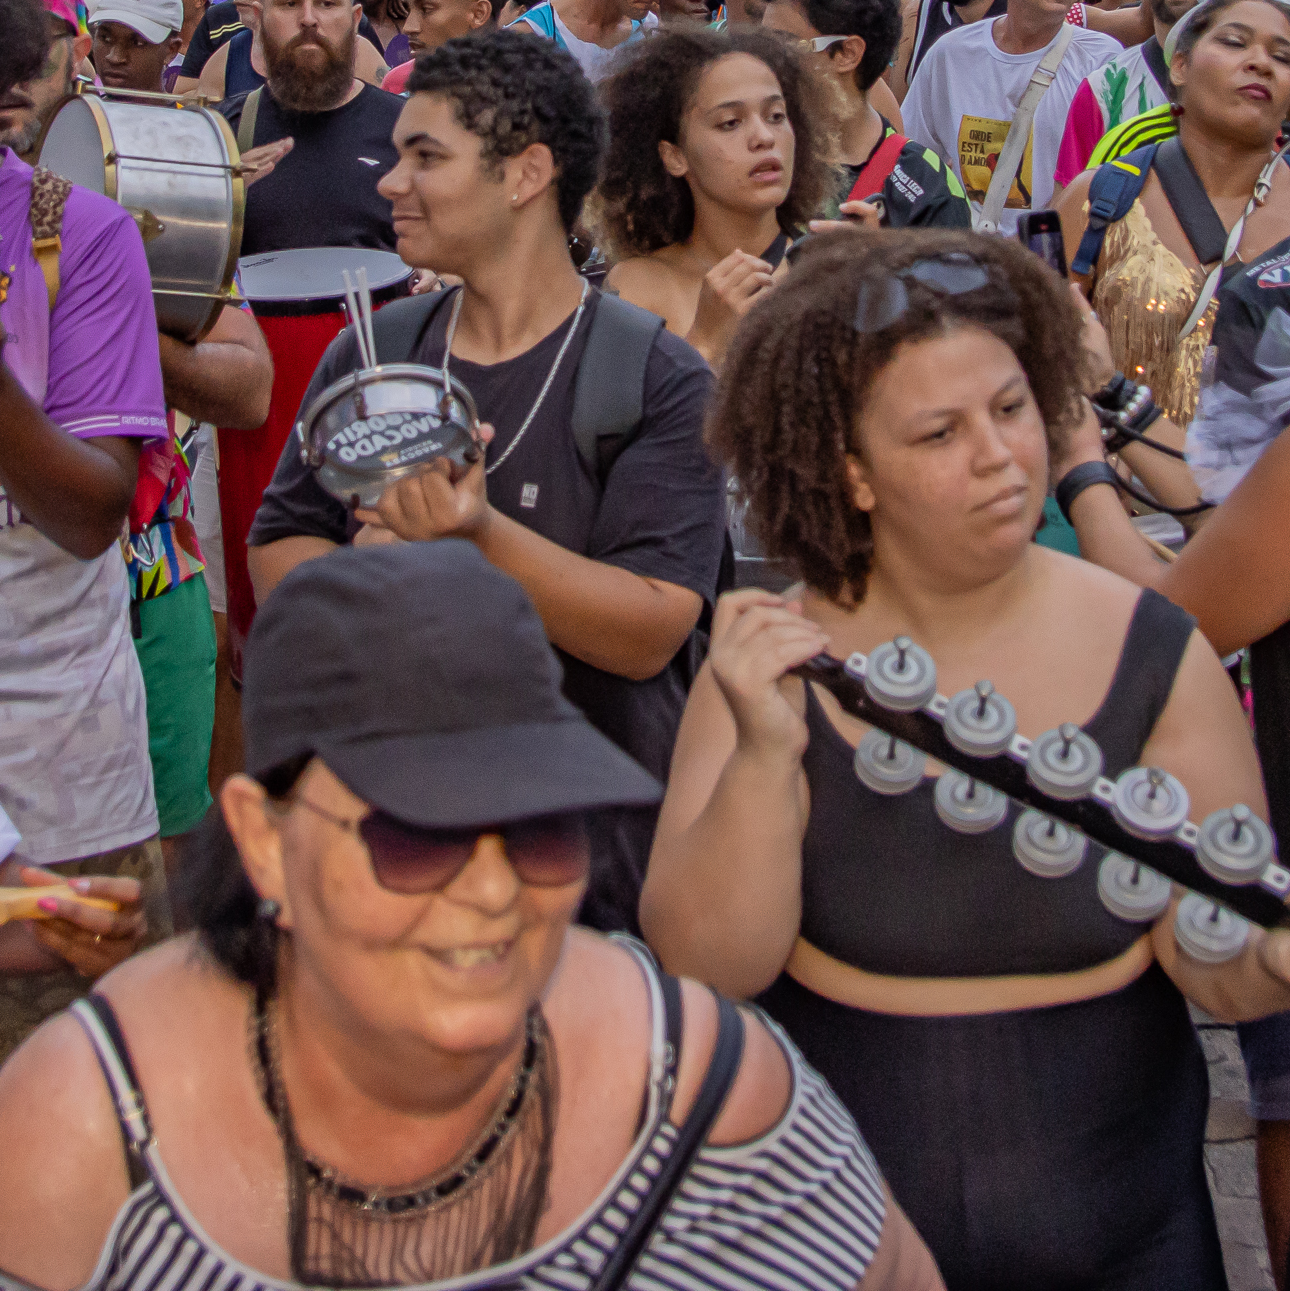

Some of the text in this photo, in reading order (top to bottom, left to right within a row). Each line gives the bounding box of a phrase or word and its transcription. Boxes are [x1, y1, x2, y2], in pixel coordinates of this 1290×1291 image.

[969, 129, 993, 143] ONDE
[961, 141, 985, 155] ESTÁ
[966, 155, 988, 167] AMO
